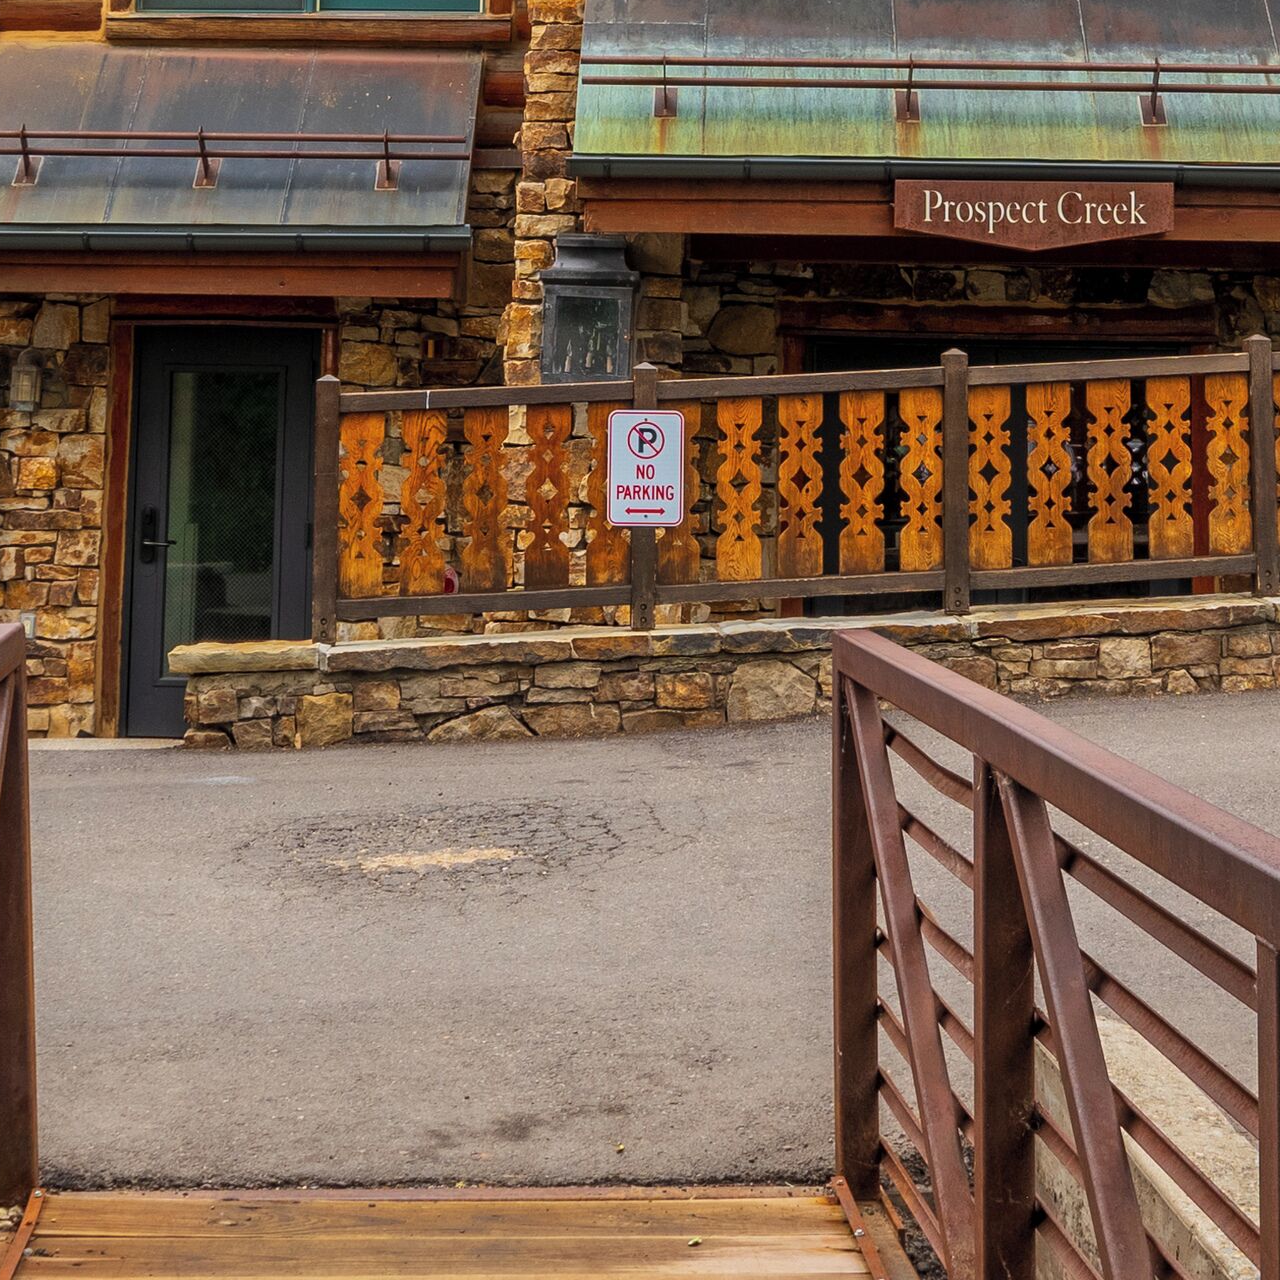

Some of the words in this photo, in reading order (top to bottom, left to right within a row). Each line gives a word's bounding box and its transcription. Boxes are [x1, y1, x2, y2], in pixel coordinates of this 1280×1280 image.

[923, 189, 1048, 234] Prospect
[1057, 190, 1148, 225] Creek
[635, 464, 655, 480] NO
[616, 485, 675, 501] PARKING
